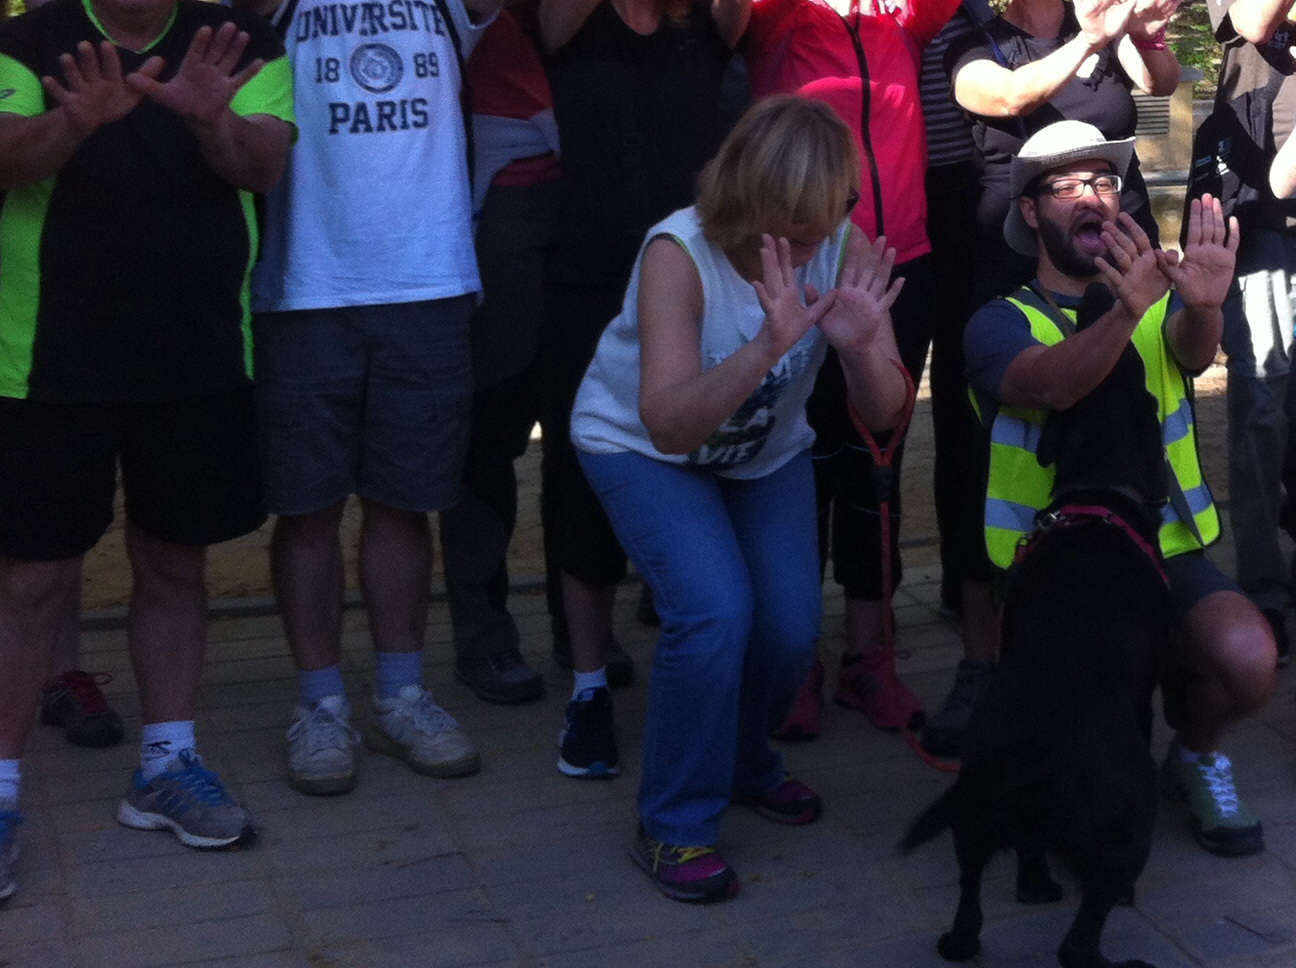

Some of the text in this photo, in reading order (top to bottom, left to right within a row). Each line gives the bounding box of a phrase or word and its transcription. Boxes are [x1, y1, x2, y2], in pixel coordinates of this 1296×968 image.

[314, 57, 341, 83] 18
[413, 52, 440, 79] 89
[328, 98, 429, 134] PARIS
